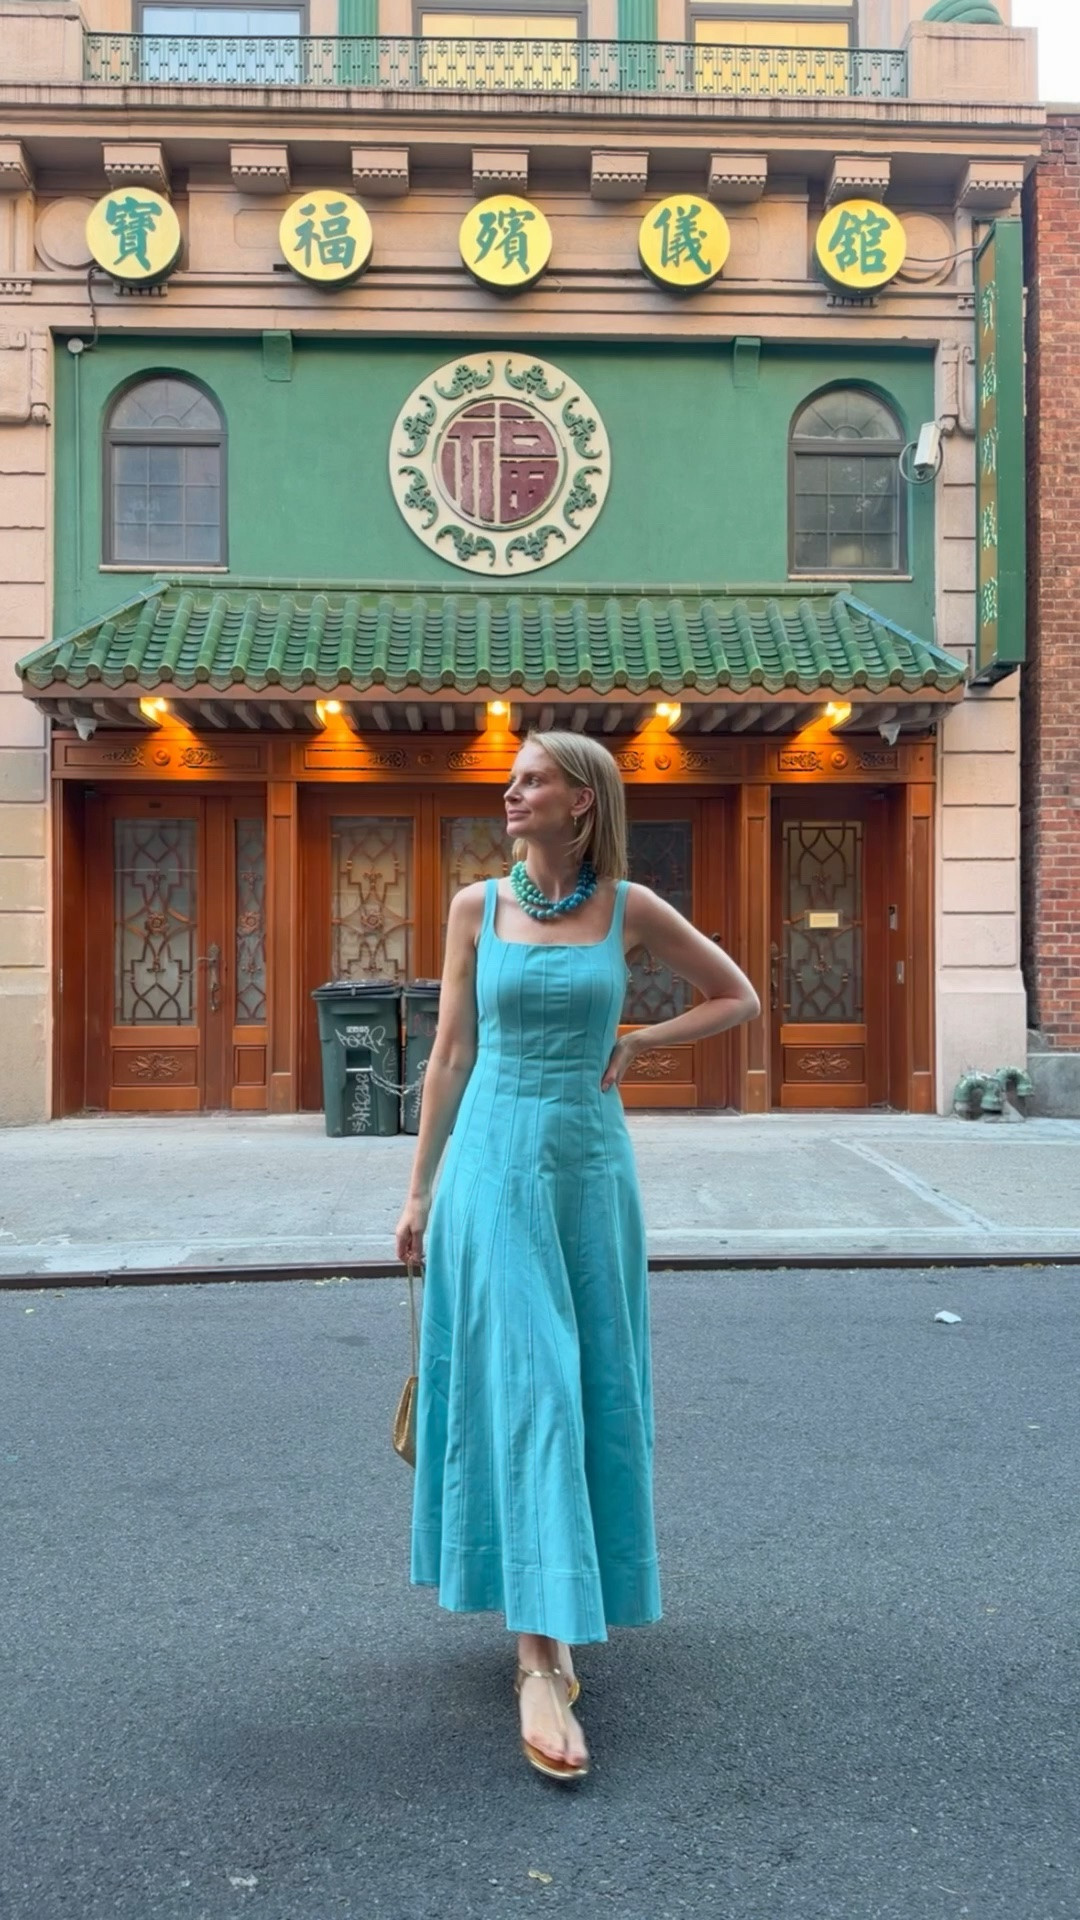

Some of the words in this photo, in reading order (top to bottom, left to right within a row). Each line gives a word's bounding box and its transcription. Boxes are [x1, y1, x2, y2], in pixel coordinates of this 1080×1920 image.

[104, 196, 888, 273] 寶福殯儀館
[440, 402, 560, 524] 福
